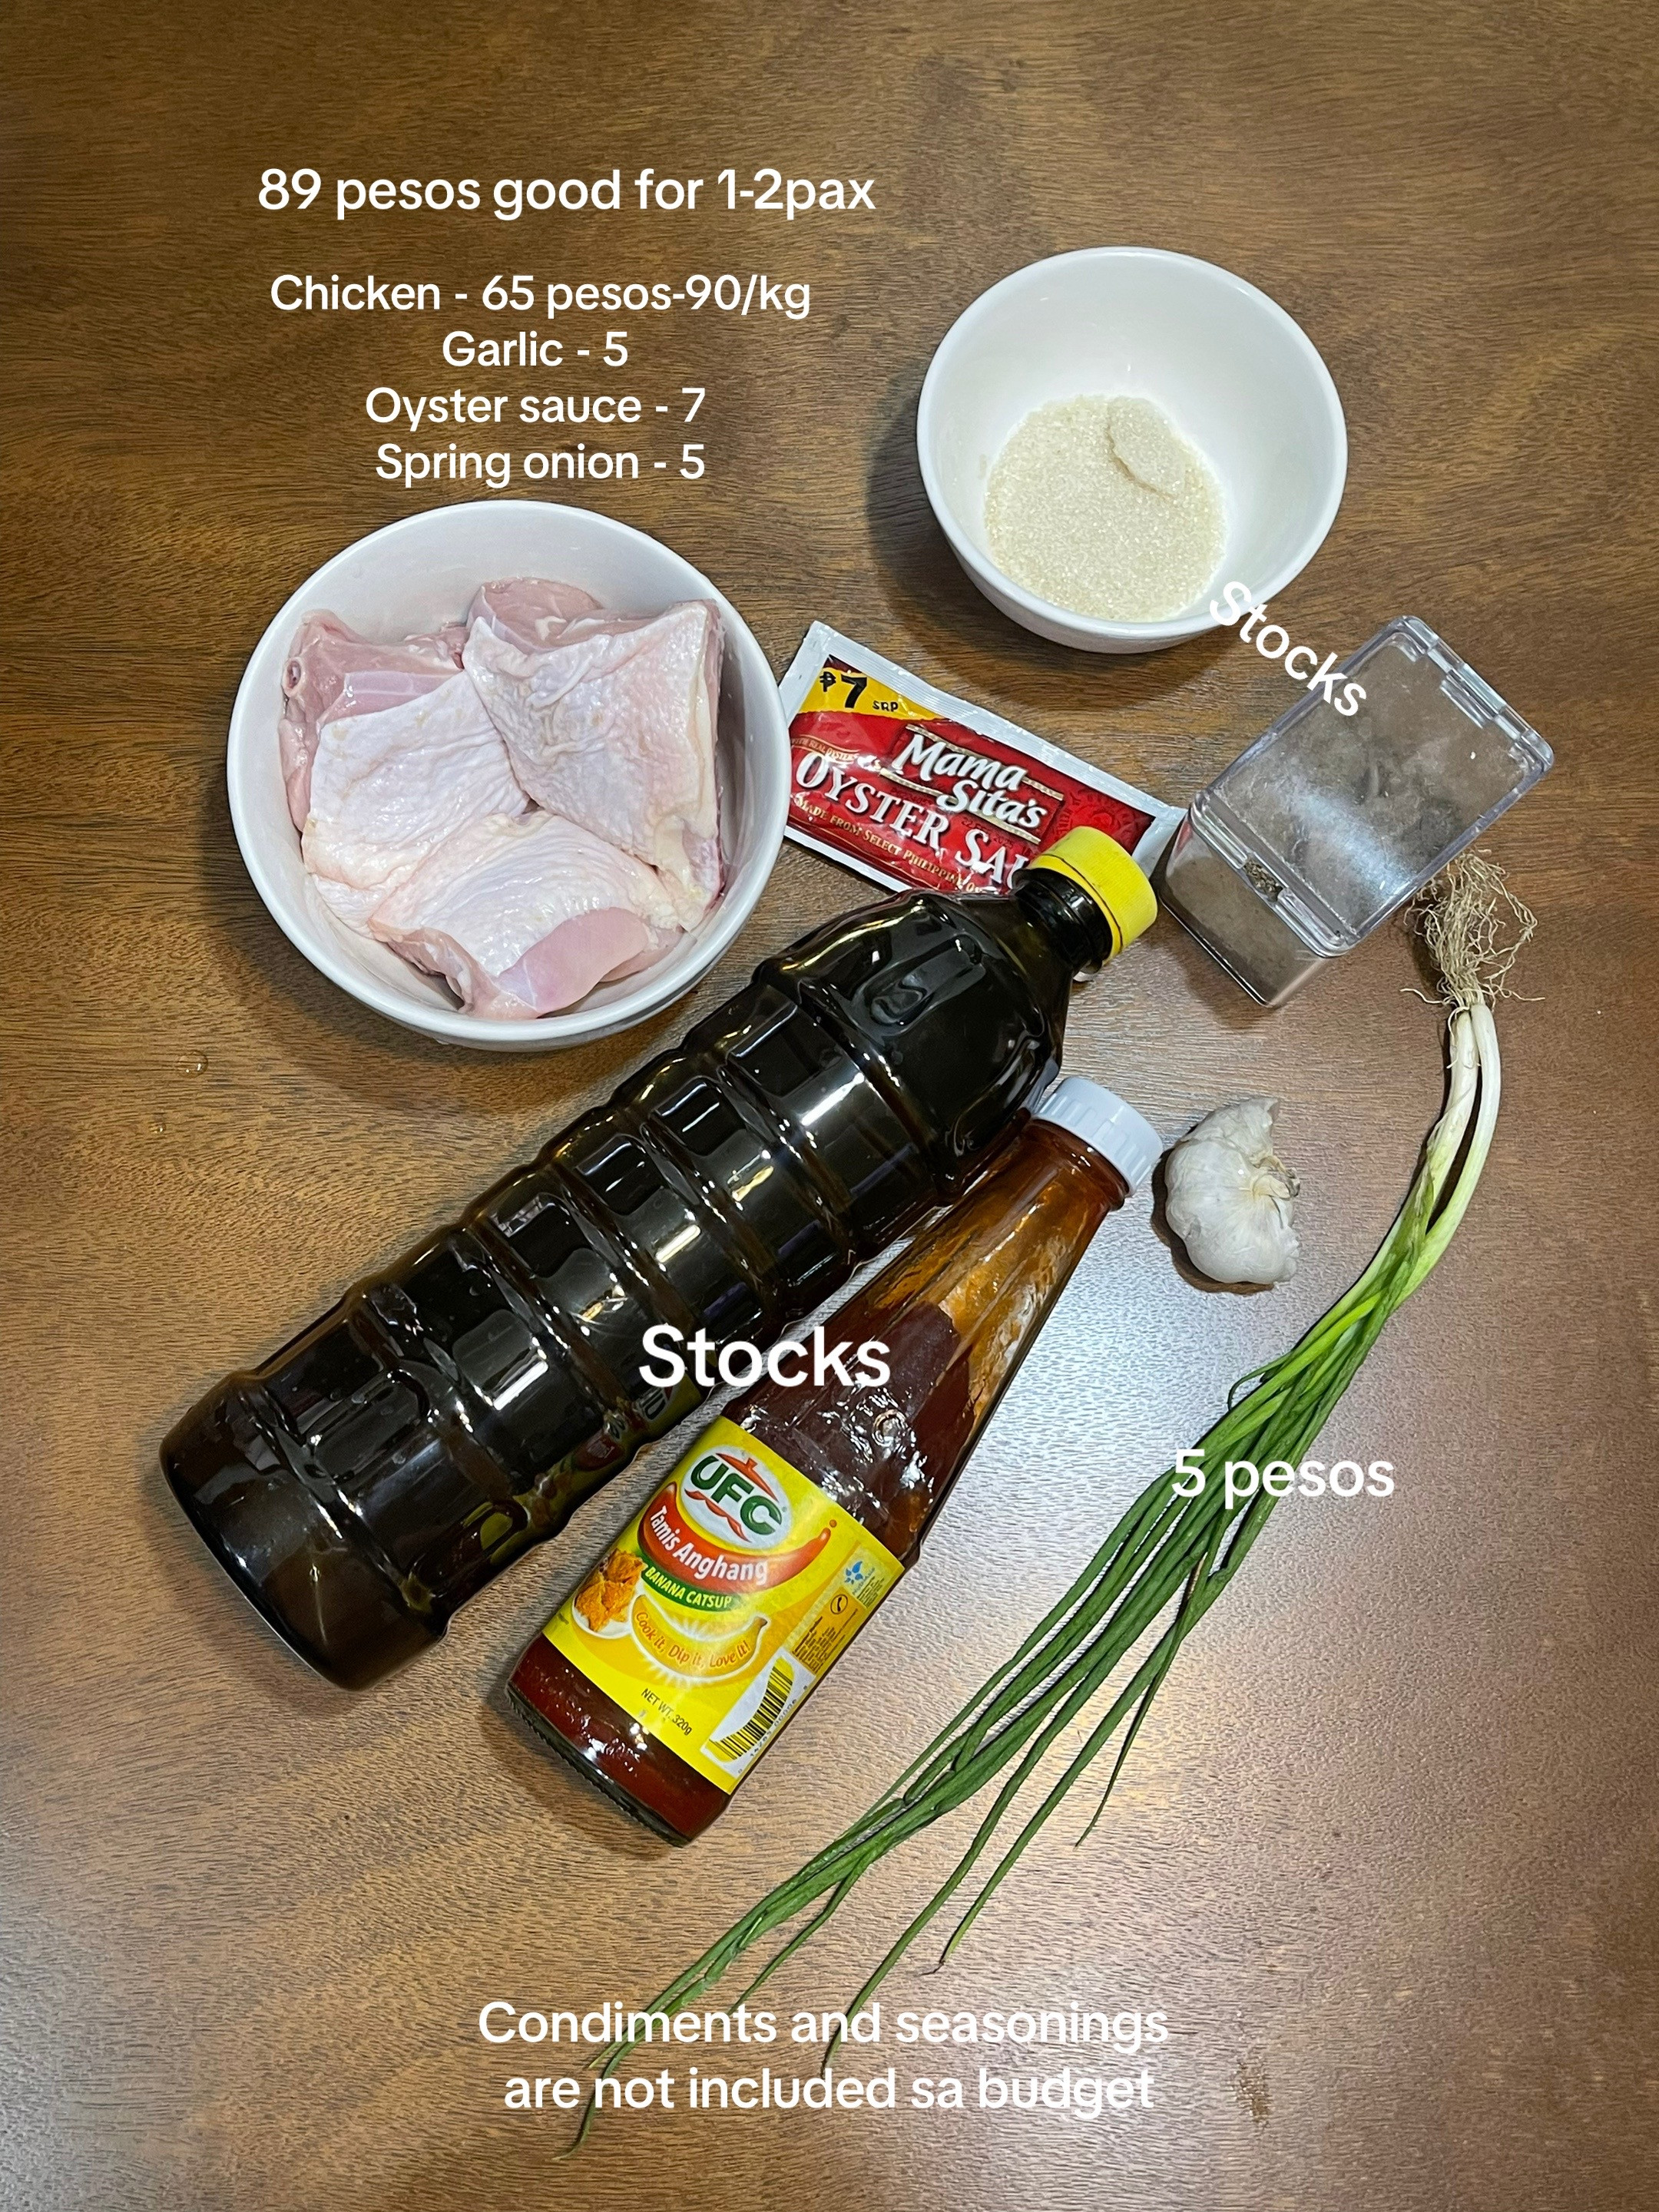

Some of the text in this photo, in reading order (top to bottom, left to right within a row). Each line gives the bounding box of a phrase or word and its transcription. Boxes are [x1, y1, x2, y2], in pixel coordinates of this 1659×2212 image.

[873, 700, 898, 712] SRP
[891, 733, 1028, 790] Mama
[796, 752, 1029, 889] OYSTER SAU
[796, 798, 827, 820] MADE
[830, 816, 863, 836] FROM
[863, 830, 902, 855] SELECT
[936, 780, 1048, 827] Sita's
[690, 1455, 782, 1535] UFC
[651, 1505, 768, 1585] Tamis Anghang
[644, 1567, 732, 1608] BANANA CATSUP
[636, 1612, 656, 1641] Cook
[654, 1636, 666, 1652] it,
[667, 1644, 689, 1664] Dip
[692, 1652, 704, 1668] it,
[710, 1653, 736, 1667] Love
[641, 1688, 692, 1736] NET WT. 320g
